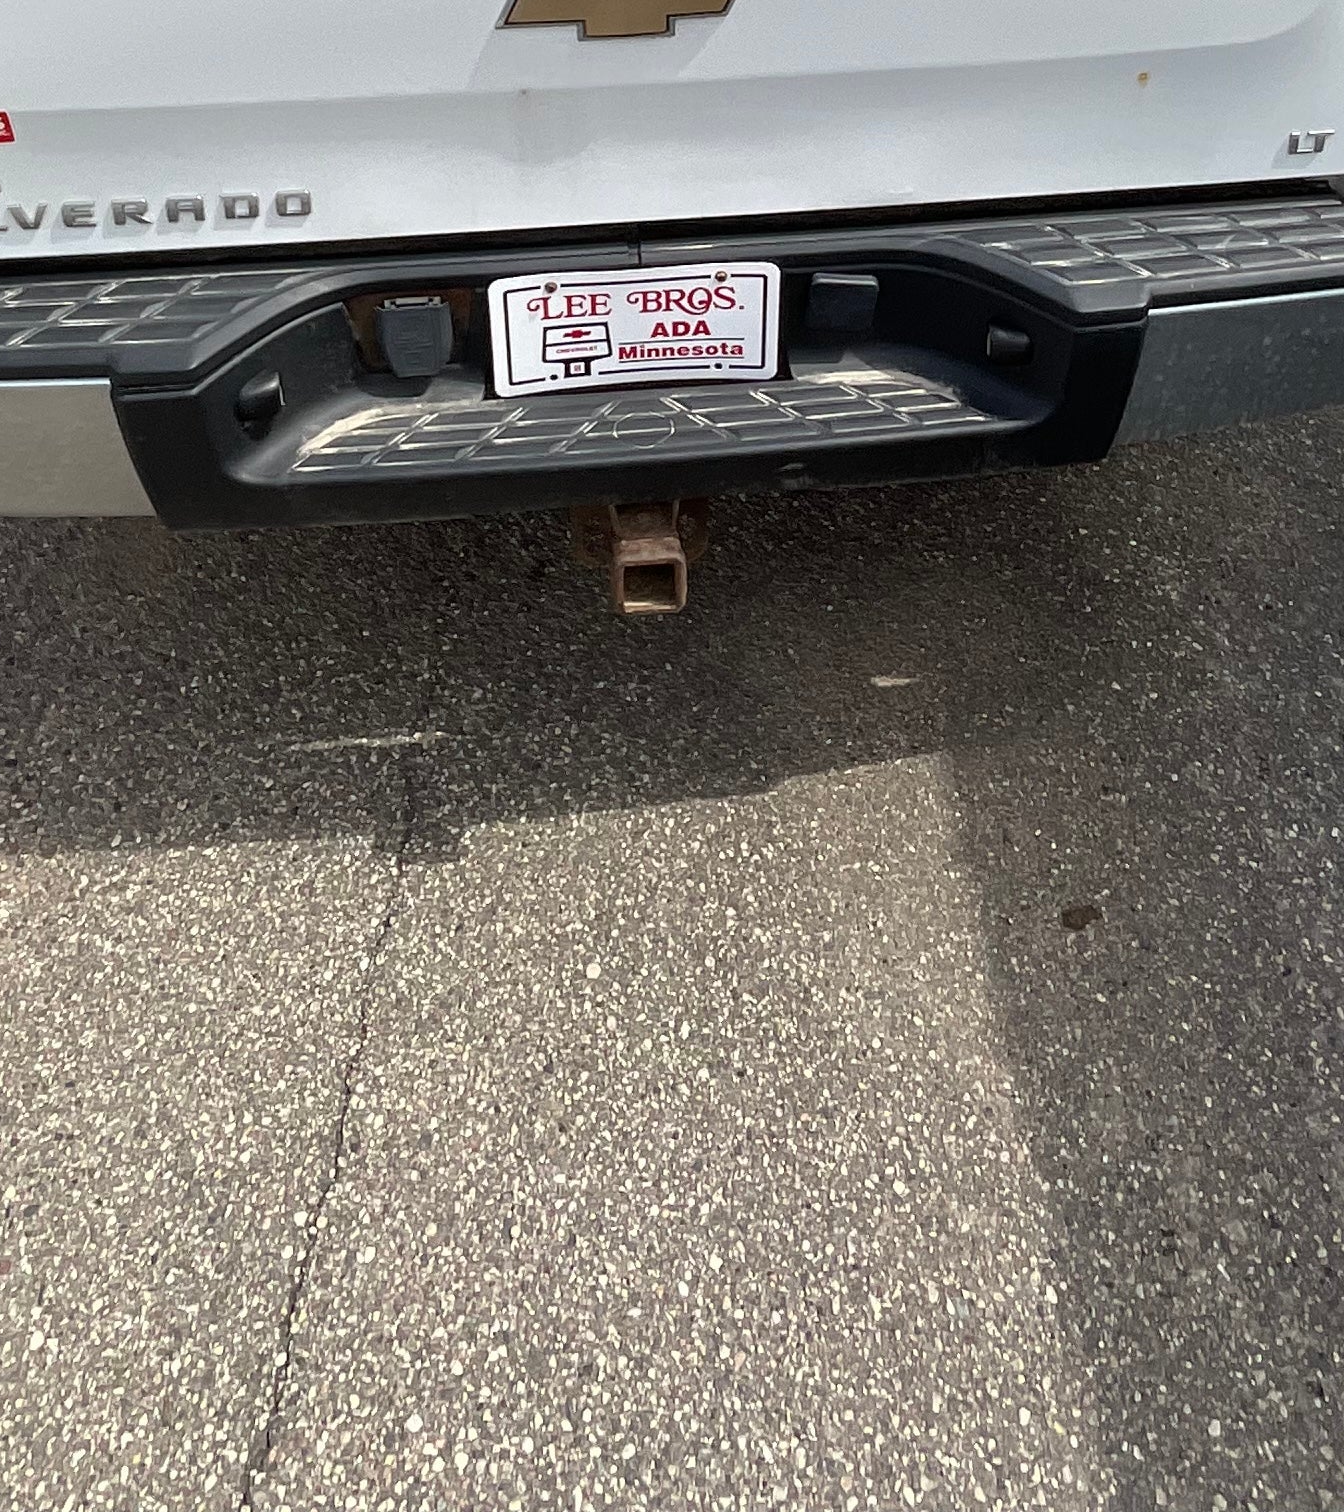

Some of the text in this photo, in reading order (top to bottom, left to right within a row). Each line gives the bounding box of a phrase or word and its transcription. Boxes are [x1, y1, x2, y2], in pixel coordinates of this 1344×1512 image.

[1288, 129, 1336, 155] LT
[527, 286, 745, 320] LEE BROS.
[650, 320, 711, 338] ADA
[618, 342, 744, 360] Minnesota
